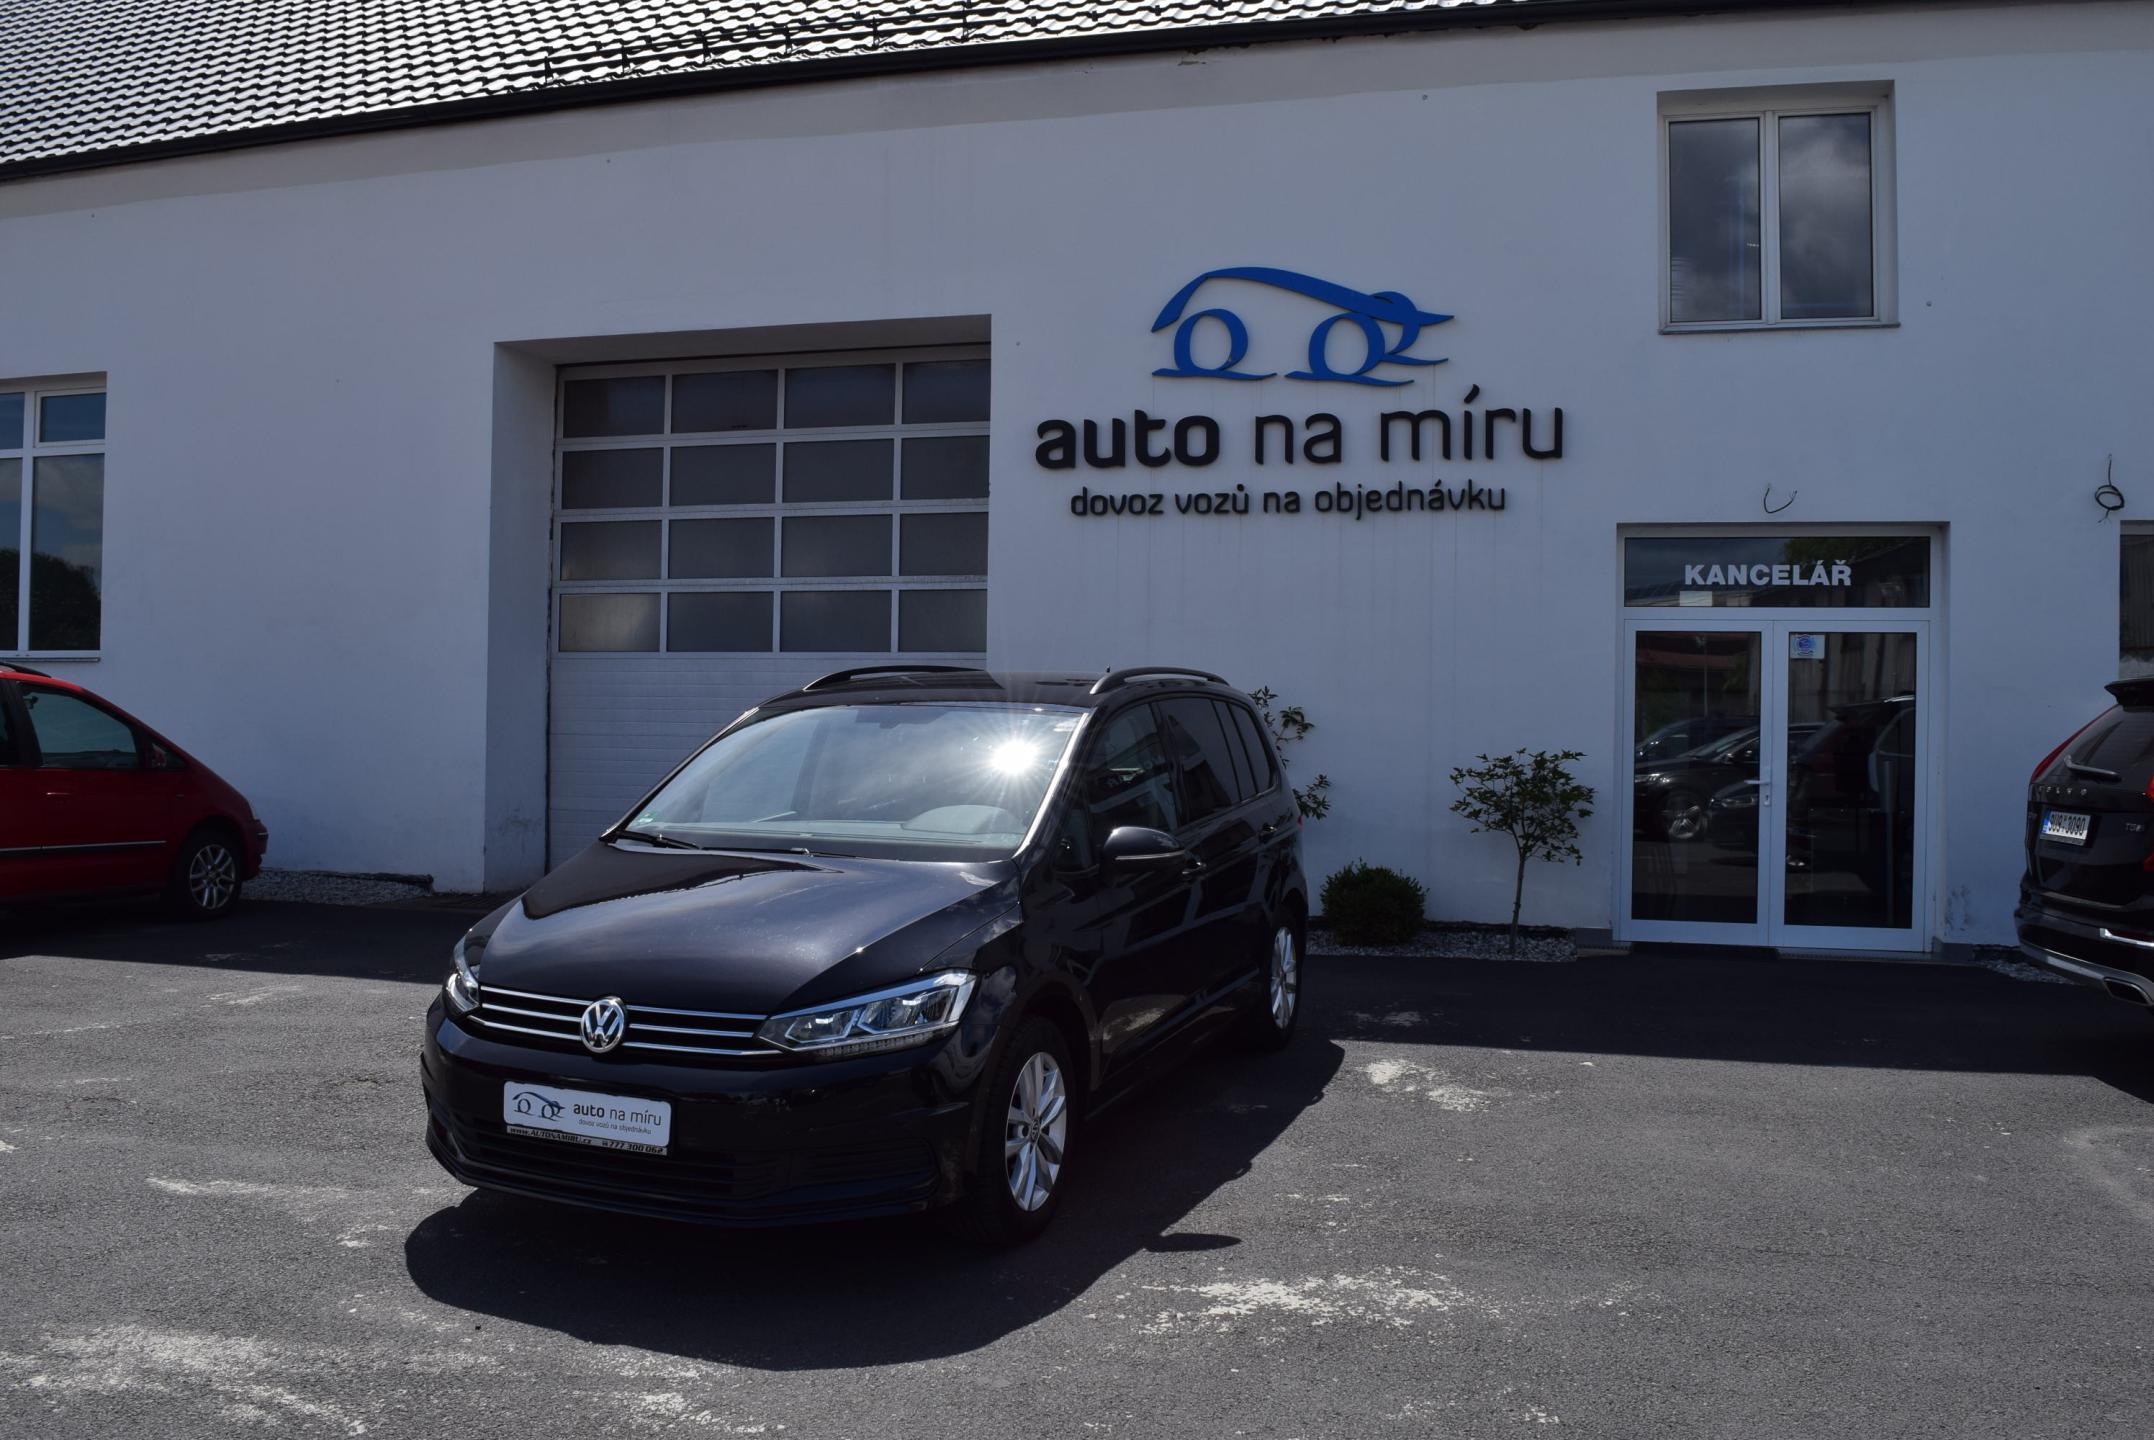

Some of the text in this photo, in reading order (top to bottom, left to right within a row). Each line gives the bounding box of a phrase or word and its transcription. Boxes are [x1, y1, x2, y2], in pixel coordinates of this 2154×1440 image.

[1035, 384, 1564, 469] auto na míru
[1070, 479, 1507, 520] dovoz vozů na objednávku
[1684, 559, 1852, 586] KANCELÁŘ
[573, 1103, 662, 1126] auto na míru
